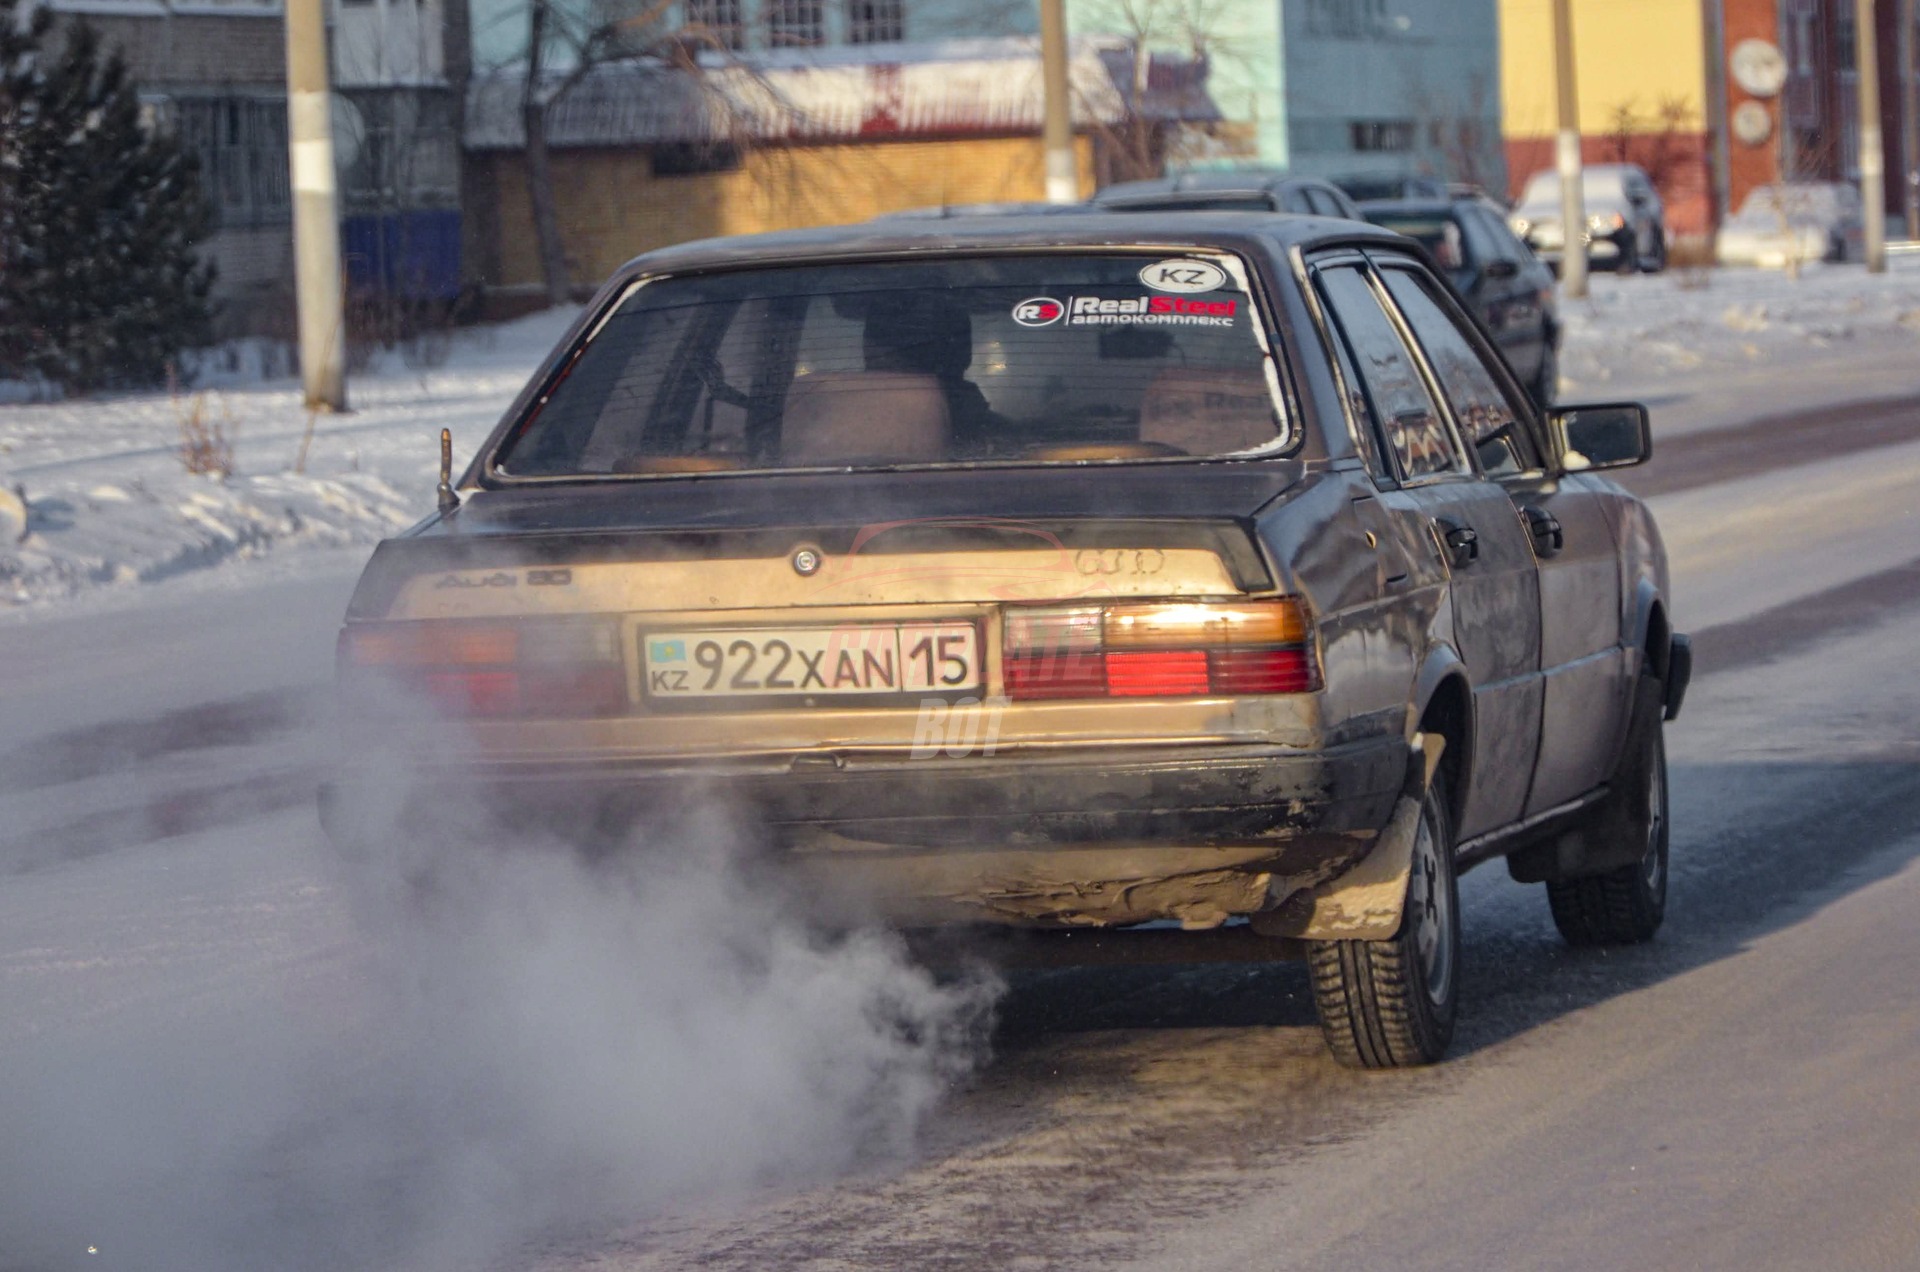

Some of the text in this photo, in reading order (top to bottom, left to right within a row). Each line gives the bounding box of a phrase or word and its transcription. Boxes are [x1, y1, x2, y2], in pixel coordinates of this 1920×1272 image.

[1158, 268, 1207, 285] KZ
[1018, 304, 1059, 321] RS
[652, 670, 689, 691] KZ
[909, 635, 968, 686] 15
